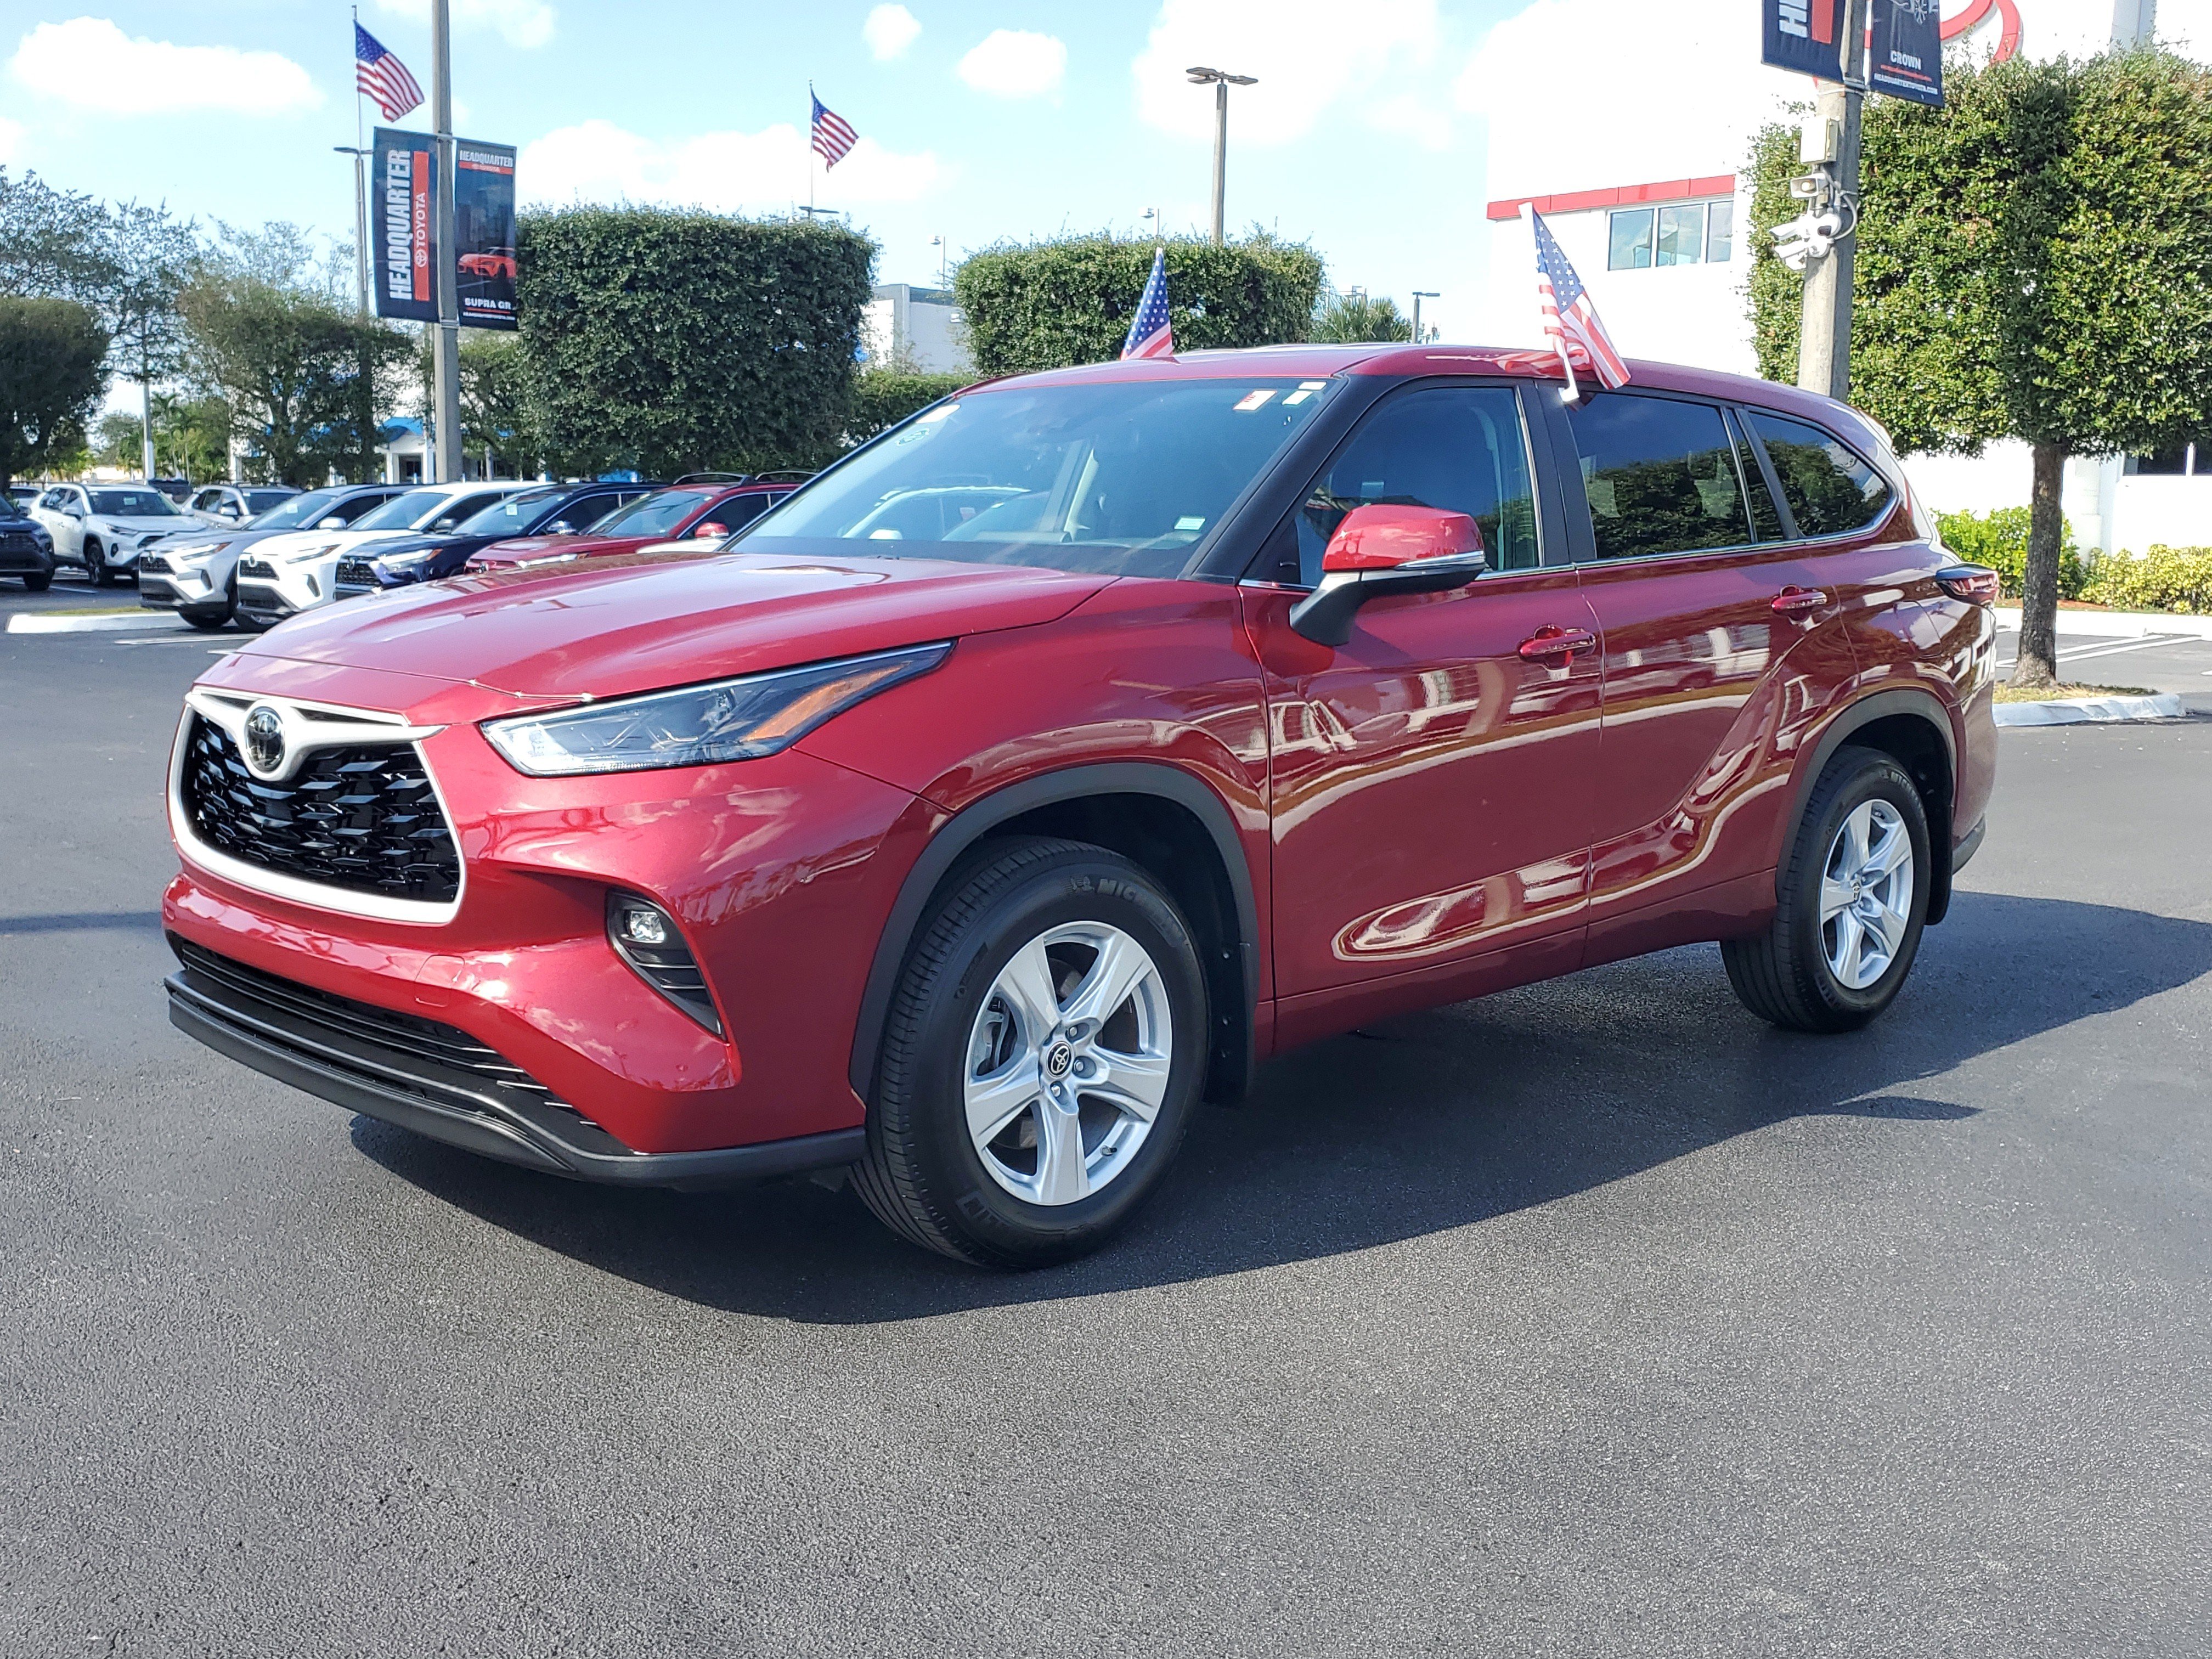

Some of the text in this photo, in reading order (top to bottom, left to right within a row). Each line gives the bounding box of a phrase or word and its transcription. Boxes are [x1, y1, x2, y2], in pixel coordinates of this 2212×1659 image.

[1890, 50, 1921, 70] CROWN
[387, 149, 413, 300] HEADQUARTER
[416, 193, 426, 248] TOYOTA
[464, 297, 511, 309] SUPRA GR
